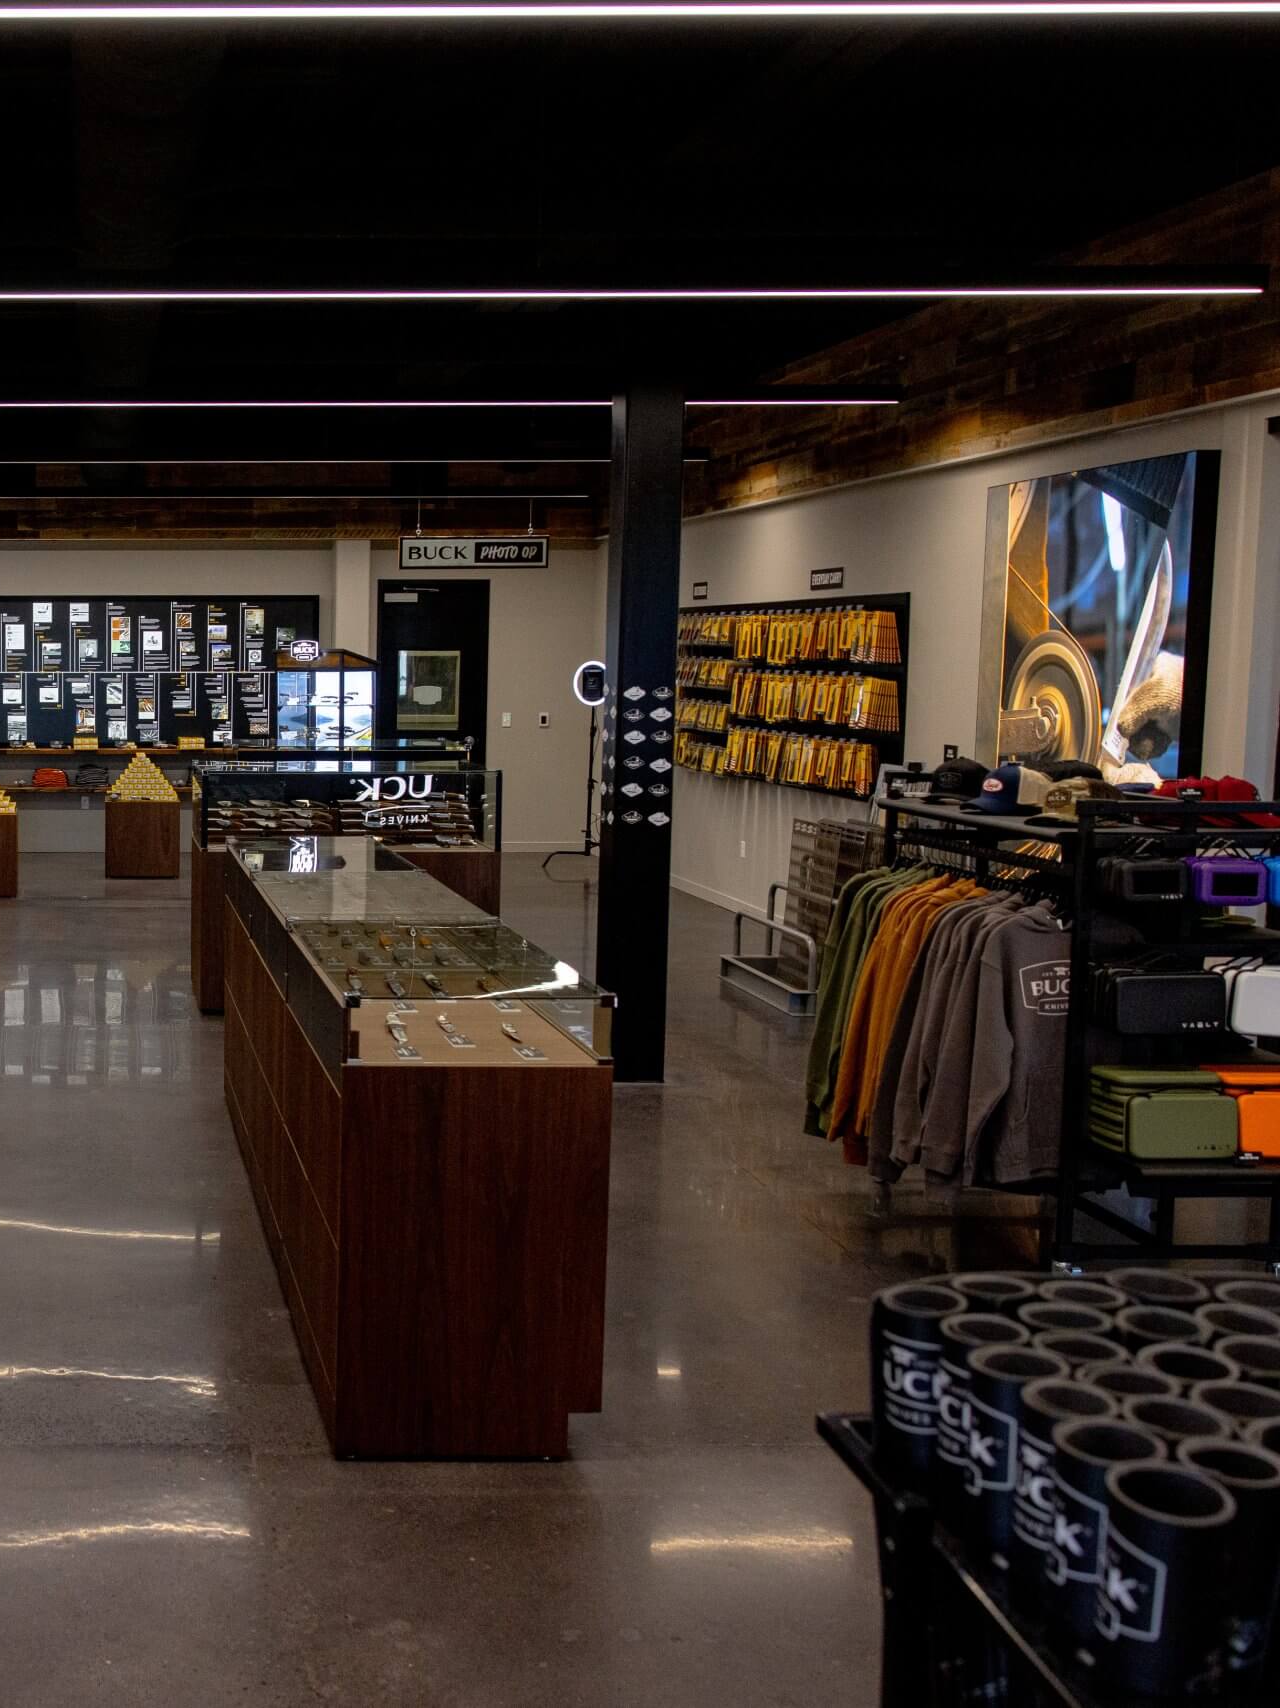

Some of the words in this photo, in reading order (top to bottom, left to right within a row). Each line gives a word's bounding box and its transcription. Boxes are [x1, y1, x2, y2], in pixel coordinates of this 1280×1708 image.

[407, 545, 468, 560] BUCK
[480, 545, 519, 560] PHOTO
[521, 546, 538, 559] OP
[1030, 978, 1071, 997] BUC
